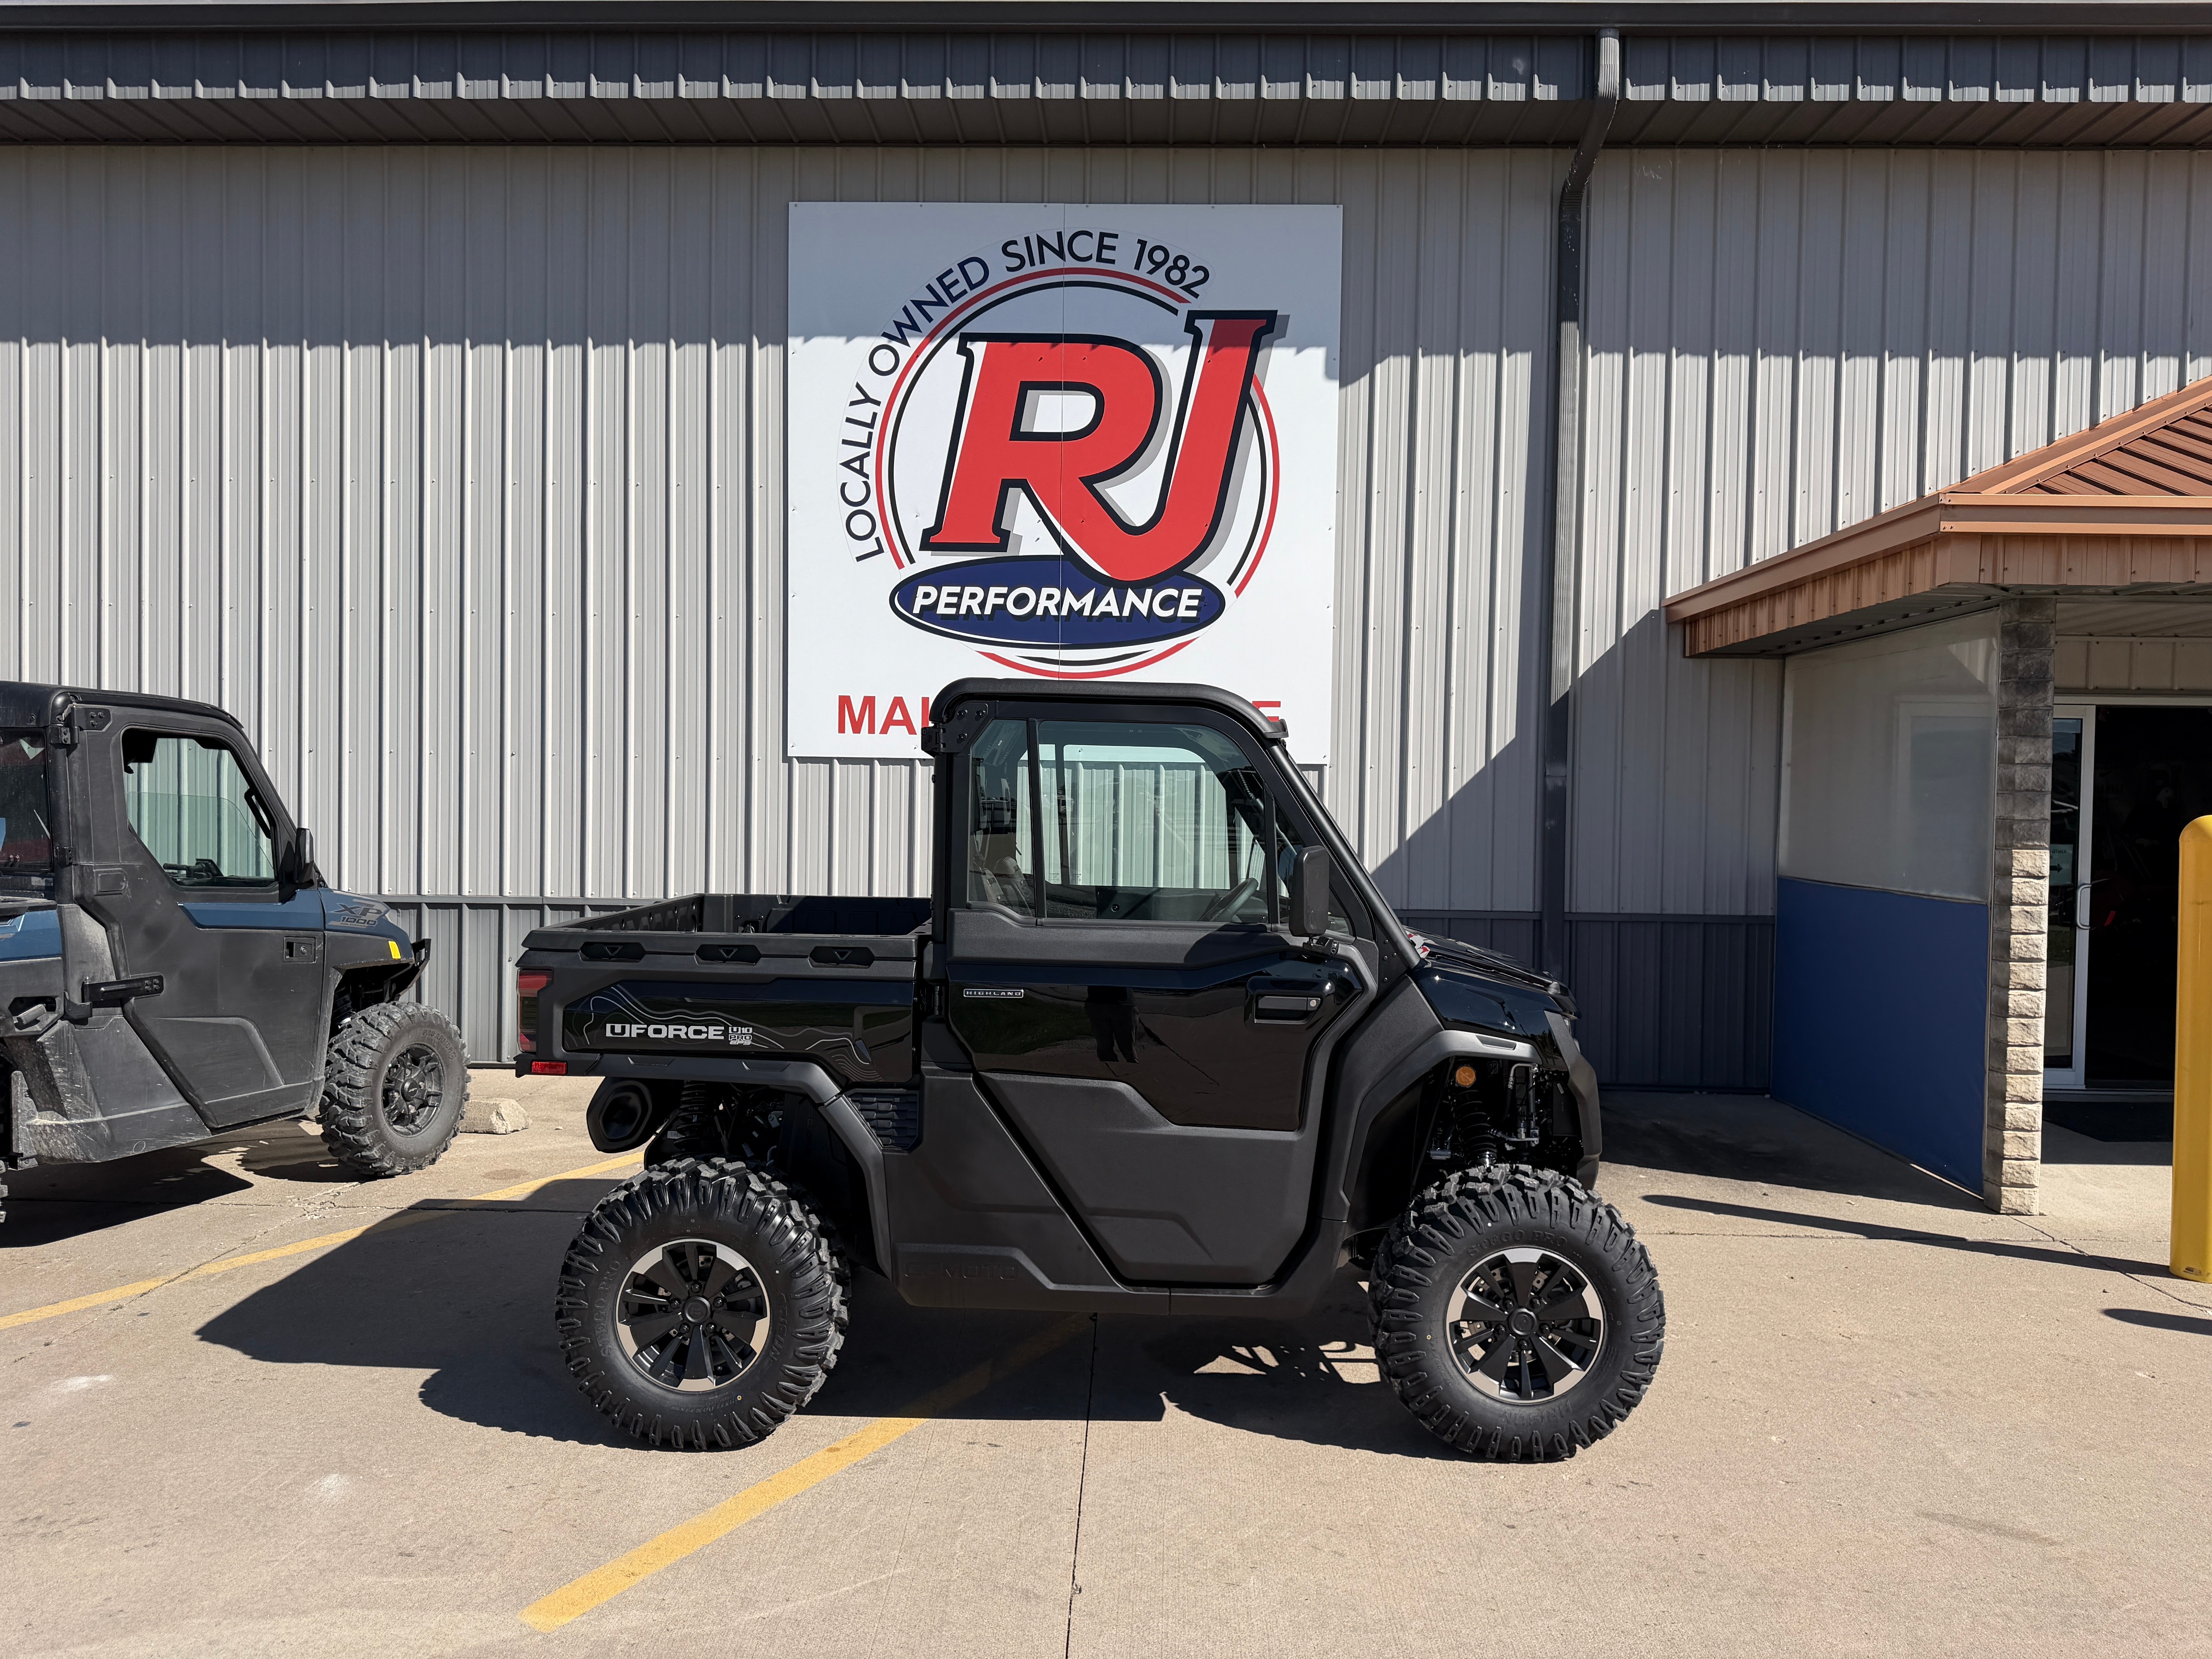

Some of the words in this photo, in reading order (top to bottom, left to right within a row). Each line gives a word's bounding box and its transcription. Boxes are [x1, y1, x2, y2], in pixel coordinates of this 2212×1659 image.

[839, 381, 884, 562] LOCALLY
[869, 256, 989, 376] OWNED
[1001, 230, 1119, 272] SINCE
[1134, 239, 1209, 299] 1982
[919, 310, 1278, 587] RJ
[912, 585, 1203, 619] PERFORMANCE
[333, 903, 383, 916] XP
[341, 916, 377, 926] 1000
[606, 1024, 724, 1039] UFORCE
[1467, 1229, 1525, 1257] STEGO
[1532, 1230, 1568, 1247] PRO
[598, 1260, 621, 1293] PRO
[904, 1261, 1019, 1280] CFMOTO
[593, 1298, 613, 1357] STEGO
